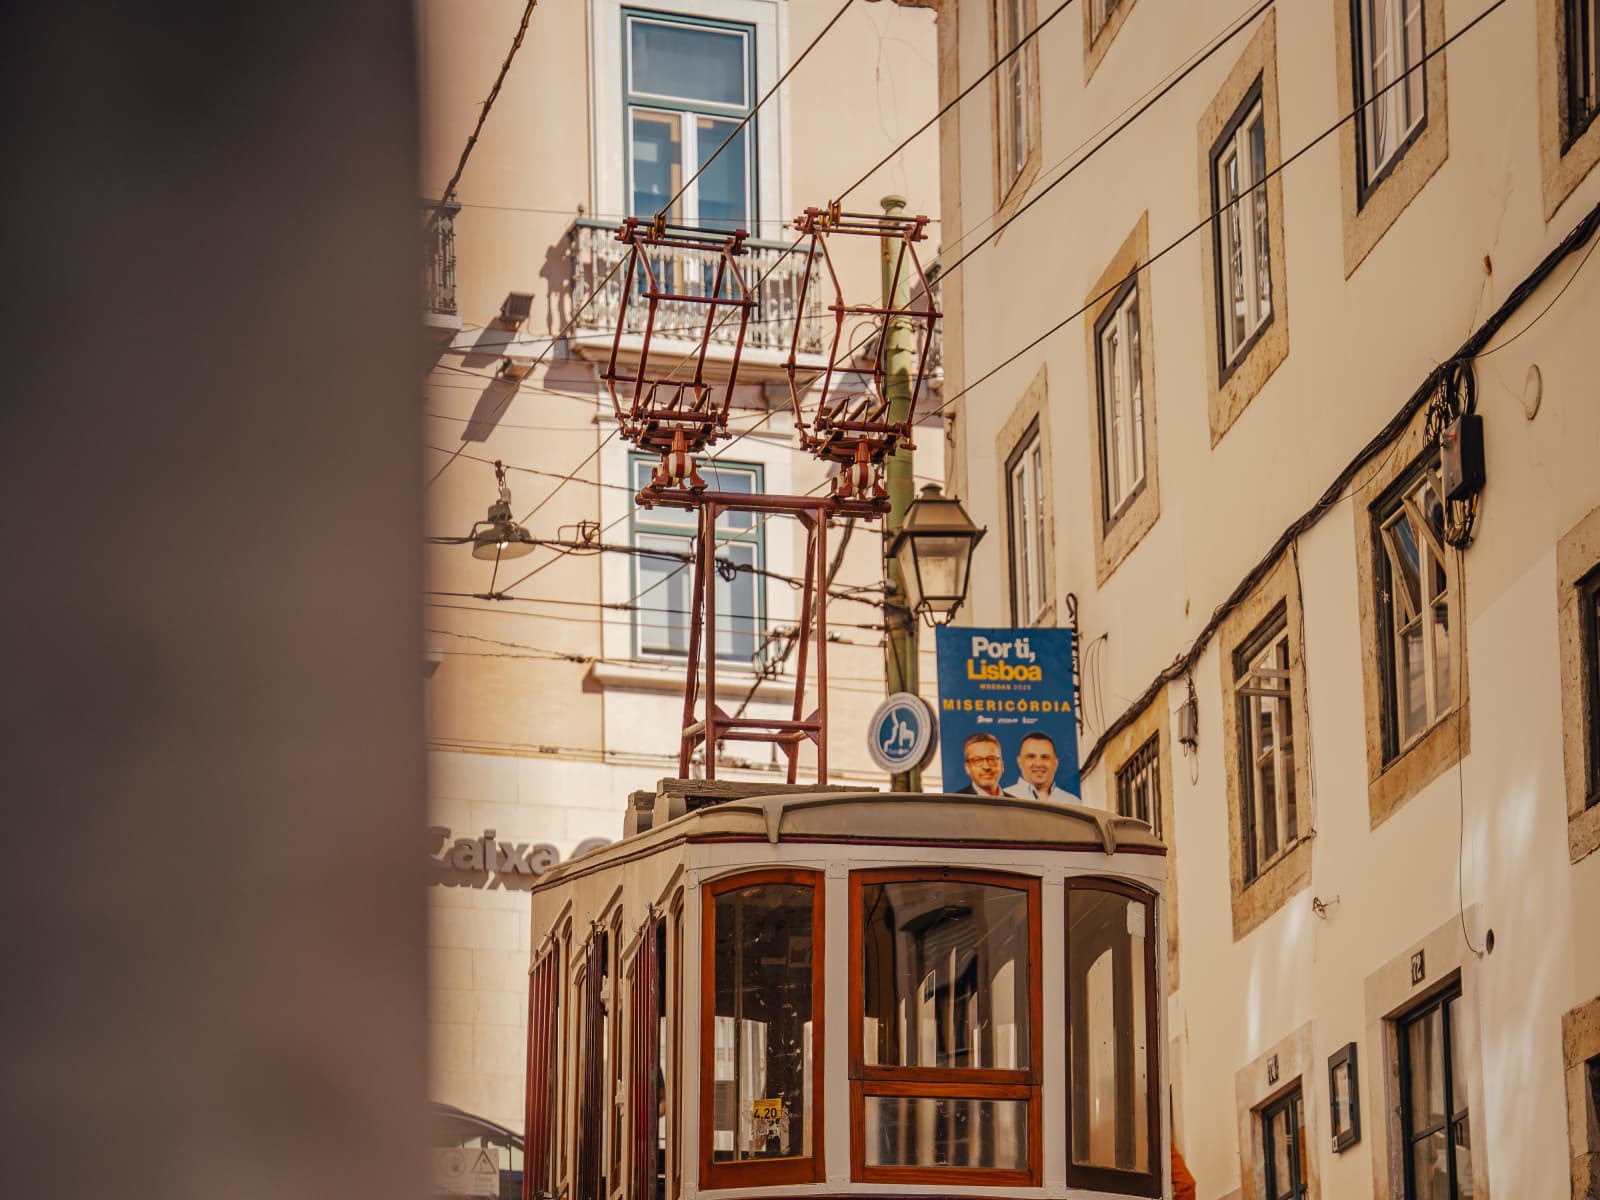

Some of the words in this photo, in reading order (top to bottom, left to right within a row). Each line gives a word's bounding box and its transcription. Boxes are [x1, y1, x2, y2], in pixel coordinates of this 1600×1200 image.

[971, 636, 1012, 658] Por
[967, 659, 1042, 681] Lisboa
[943, 698, 1071, 712] MISERICÓRDIA
